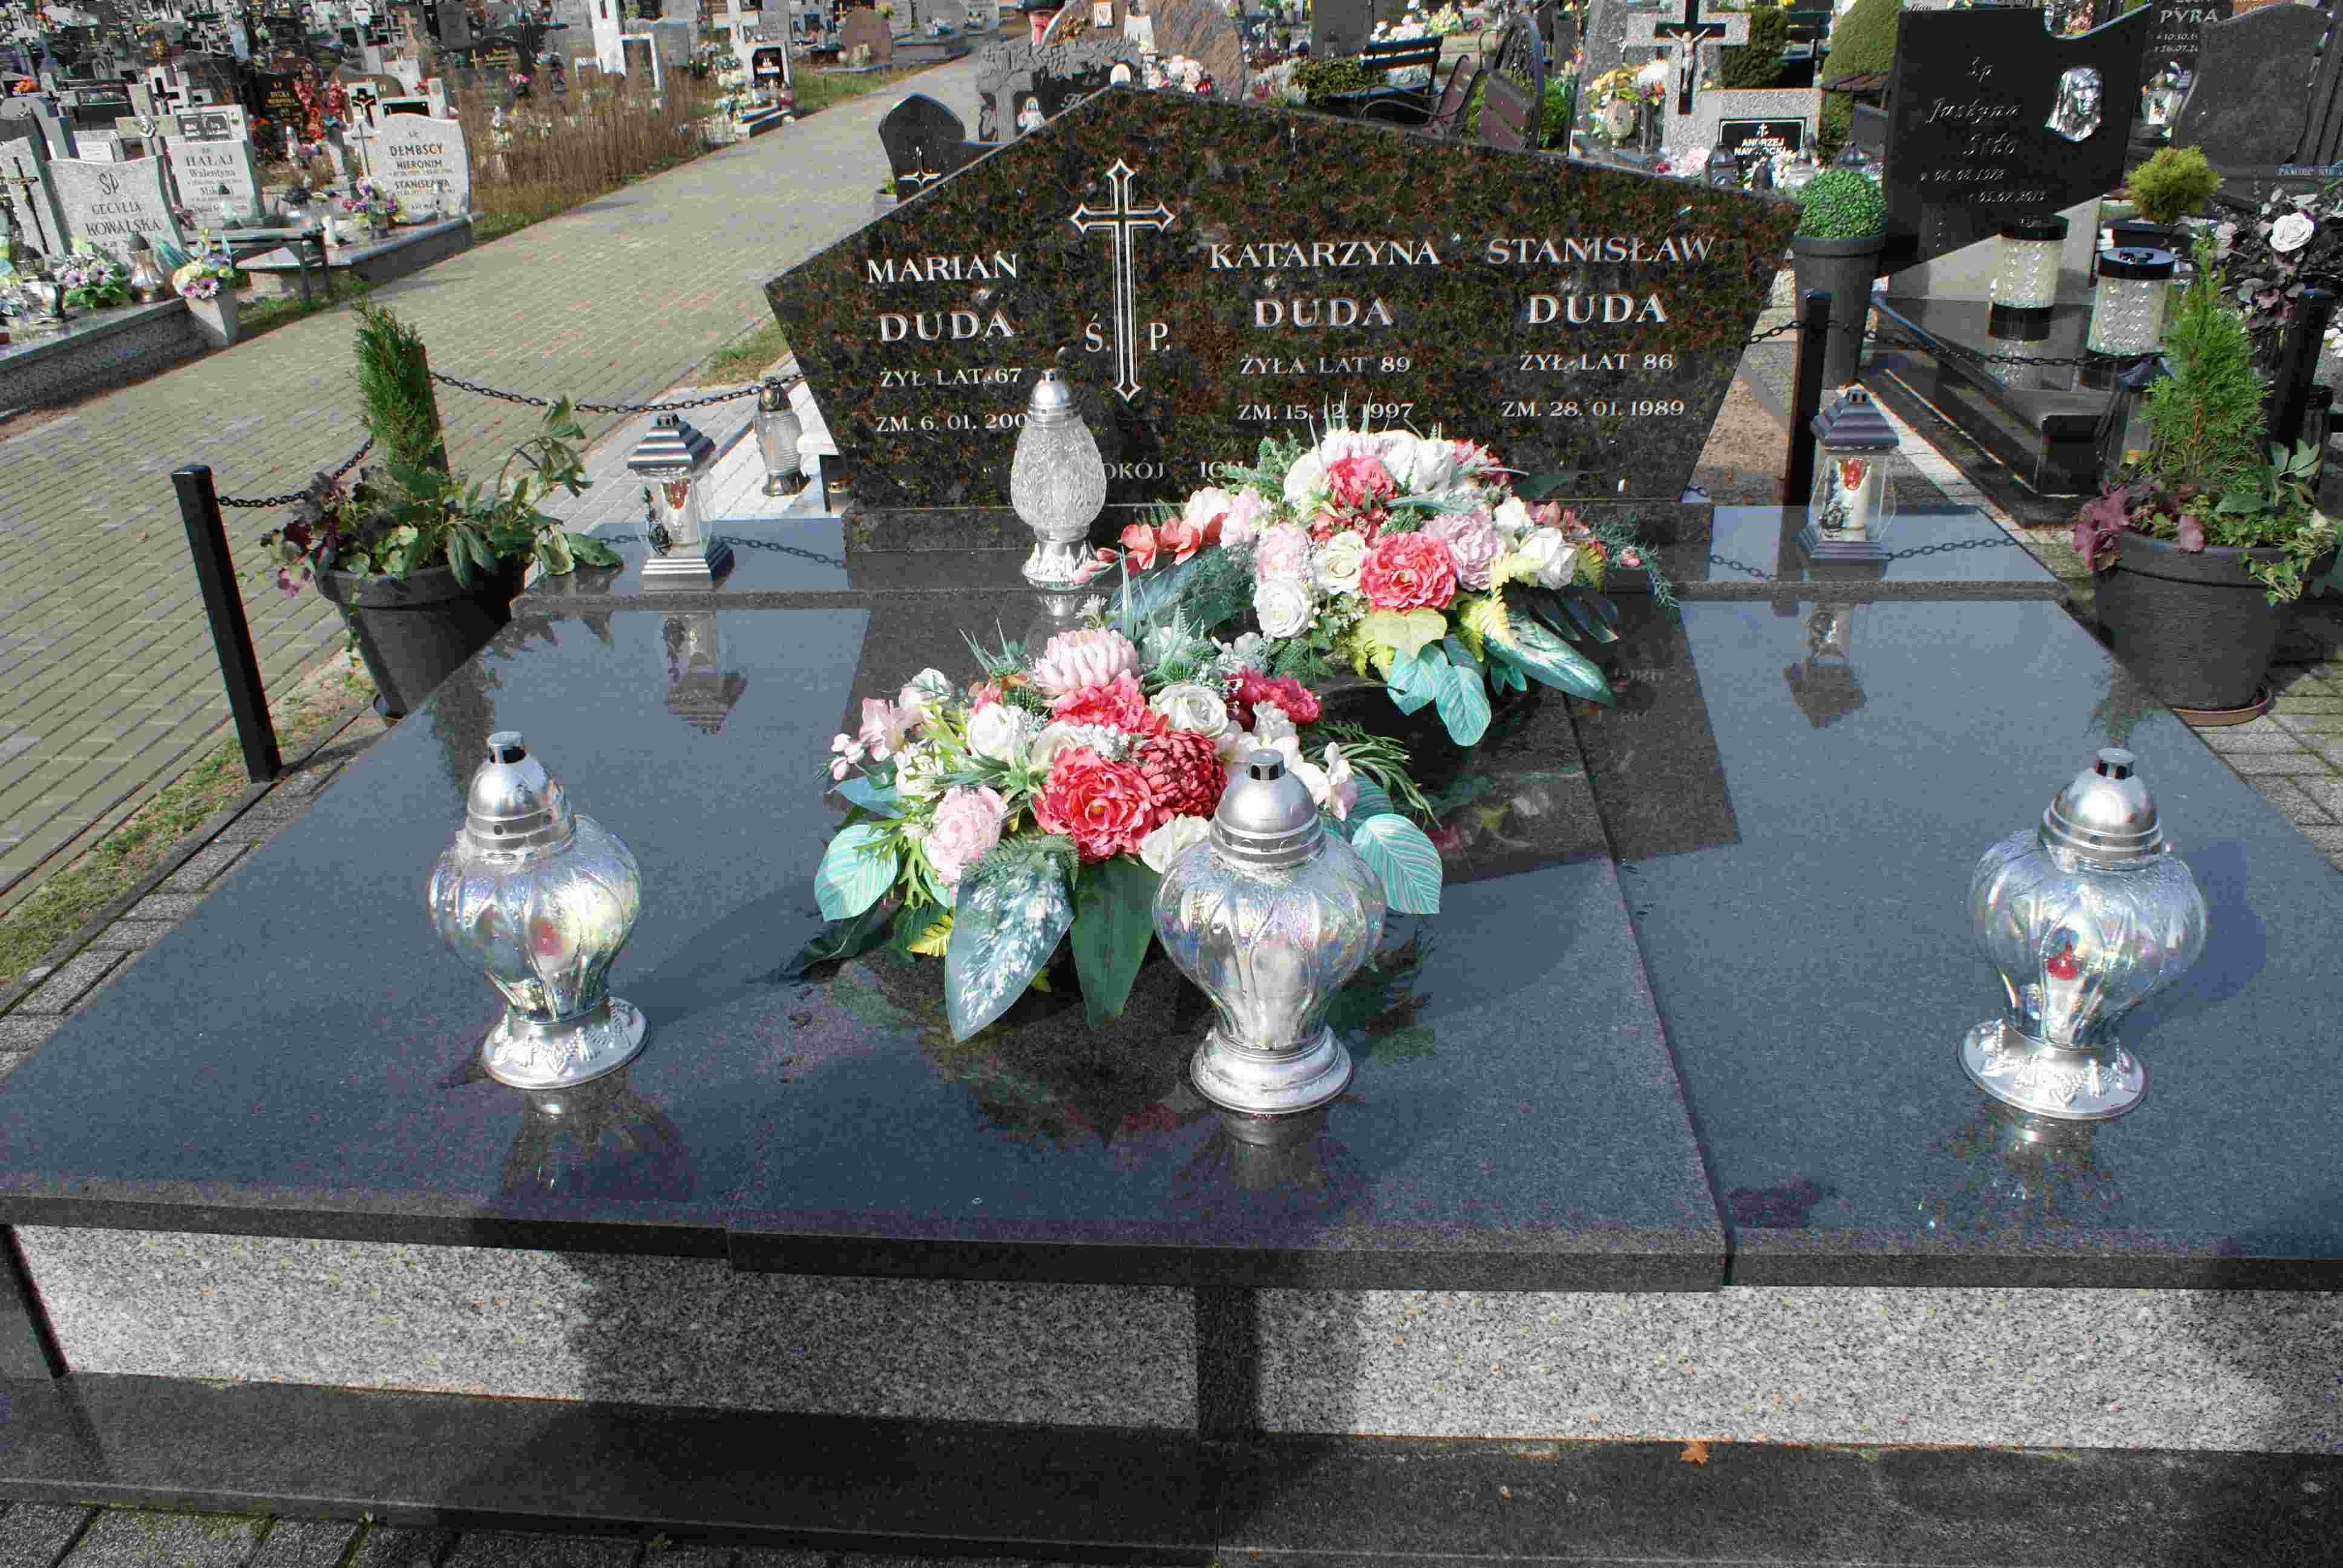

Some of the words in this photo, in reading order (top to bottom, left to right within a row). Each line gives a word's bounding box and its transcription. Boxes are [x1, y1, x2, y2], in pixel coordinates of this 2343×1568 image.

[396, 159, 443, 169] HIERONIM
[1210, 240, 1442, 270] KATARZYNA
[1487, 237, 1715, 265] STANISŁAW
[867, 250, 1018, 283] MARIAN
[1254, 296, 1394, 329] DUDA
[1528, 292, 1668, 324] DUDA
[879, 309, 1015, 343] DUDA
[1149, 322, 1171, 351] P.
[1240, 353, 1306, 374] ŻYŁA
[1318, 357, 1364, 373] LAT
[1380, 356, 1411, 373] 89
[1520, 350, 1565, 371] ŻYŁ
[1579, 353, 1630, 371] LAT
[1642, 353, 1674, 370] 86
[879, 367, 926, 387] ŻYŁ
[937, 368, 983, 385] LAT
[994, 368, 1022, 384] 67
[1237, 404, 1278, 420] ZM.
[1362, 403, 1414, 419] 1997
[1501, 400, 1542, 417] ZM.
[1549, 401, 1583, 417] 28.
[1630, 400, 1685, 417] 1989
[876, 415, 914, 433] ZM.
[984, 413, 1028, 430] 200
[1103, 457, 1164, 480] OKÓJ
